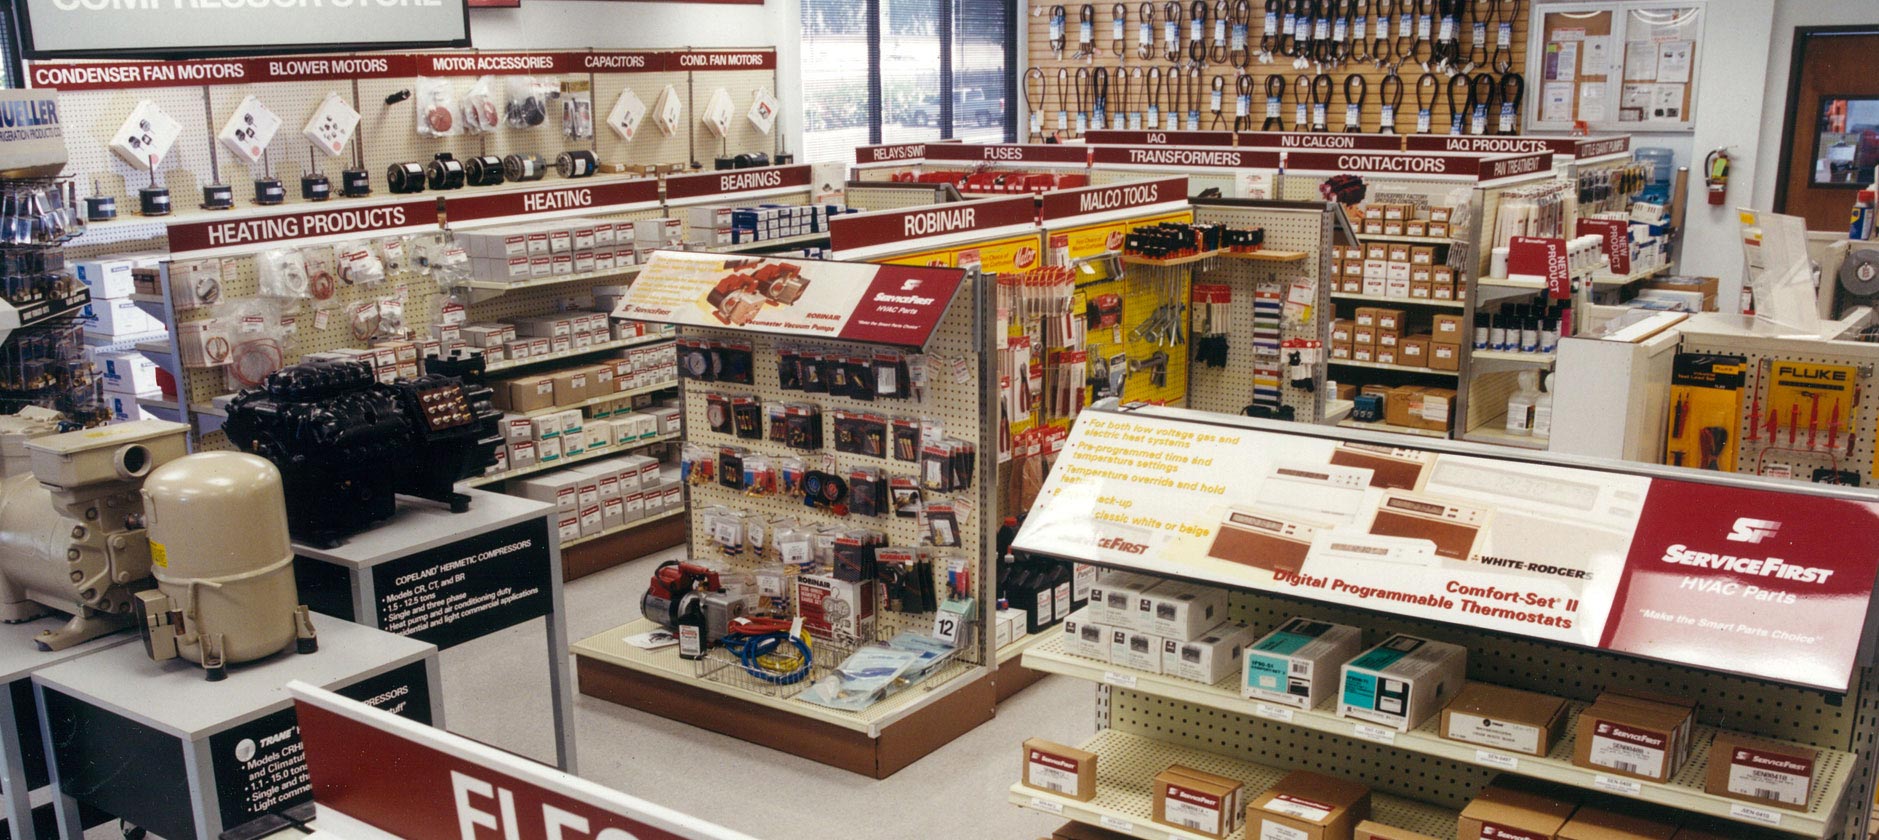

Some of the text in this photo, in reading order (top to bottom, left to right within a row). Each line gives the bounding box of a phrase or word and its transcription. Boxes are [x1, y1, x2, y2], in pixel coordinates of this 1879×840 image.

[270, 58, 388, 76] BLOWER MOTORS
[433, 56, 553, 71] MOTOR ACCESSORIES
[584, 56, 644, 68] CAPACITORS
[680, 54, 763, 66] COND. FAN MOTORS
[36, 63, 244, 85] CONDENSER FAN MOTORS
[0, 100, 58, 128] UELLER
[1147, 134, 1166, 144] IAQ
[1281, 135, 1354, 148] NU CALGON
[1446, 139, 1547, 152] IAQ PRODUCTS
[984, 147, 1022, 160] FUSES
[1129, 150, 1241, 166] TRANSFORMERS
[1338, 156, 1446, 172] CONTACTORS
[1494, 157, 1540, 176] PAN TREATMENT
[720, 170, 781, 191] BEARINGS
[524, 189, 591, 212] HEATING
[1080, 184, 1157, 212] MALCO TOOLS
[208, 206, 406, 245] HEATING PRODUCTS
[904, 208, 975, 237] ROBINAIR
[1610, 225, 1620, 268] PRODUCT
[1619, 236, 1628, 256] NEW
[1548, 244, 1559, 293] PRODUCT
[1557, 256, 1566, 279] NEW
[806, 312, 841, 320] ROBINAIR
[876, 305, 918, 315] HVAC Parts
[811, 324, 835, 332] Pumps
[1779, 366, 1847, 381] FLUKE
[1084, 428, 1190, 449] electric heat systems
[1089, 418, 1240, 445] For both low voltage gas and
[1073, 451, 1179, 473] temperature settings
[1077, 441, 1213, 467] Pre-programmed time and
[1066, 464, 1226, 495] Temperature override and hold
[1097, 495, 1132, 508] ack-up
[1094, 510, 1210, 537] classic white or beige
[440, 553, 477, 573] HERMETIC
[478, 539, 532, 562] COMPRESSORS
[1481, 556, 1593, 580] WHITE-RODGERS
[386, 590, 413, 603] Models
[441, 578, 454, 588] and
[455, 573, 465, 582] BR
[798, 576, 830, 588] ROBINAIR
[1680, 576, 1797, 605] HVAC Parts
[388, 603, 398, 612] 1.5
[404, 597, 418, 608] 12.5
[420, 593, 436, 603] tons
[389, 592, 467, 623] Single and three phase
[389, 621, 406, 631] Heat
[408, 614, 428, 626] pump
[430, 609, 443, 618] and
[454, 593, 496, 610] conditioning
[497, 587, 512, 598] duty
[430, 619, 443, 628] and
[444, 612, 460, 625] light
[461, 600, 499, 617] commercial
[500, 587, 538, 605] applications
[1273, 568, 1572, 629] Digital Programmable Thermostats
[1566, 600, 1578, 612] II
[938, 619, 954, 636] 12
[1676, 614, 1695, 626] the
[1697, 618, 1734, 632] Smart
[1737, 623, 1768, 637] Parts
[248, 752, 280, 770] Models
[249, 770, 266, 781] and
[251, 780, 263, 791] 1.1
[271, 770, 289, 782] 15.0
[252, 779, 298, 802] Single and
[254, 797, 276, 812] Light
